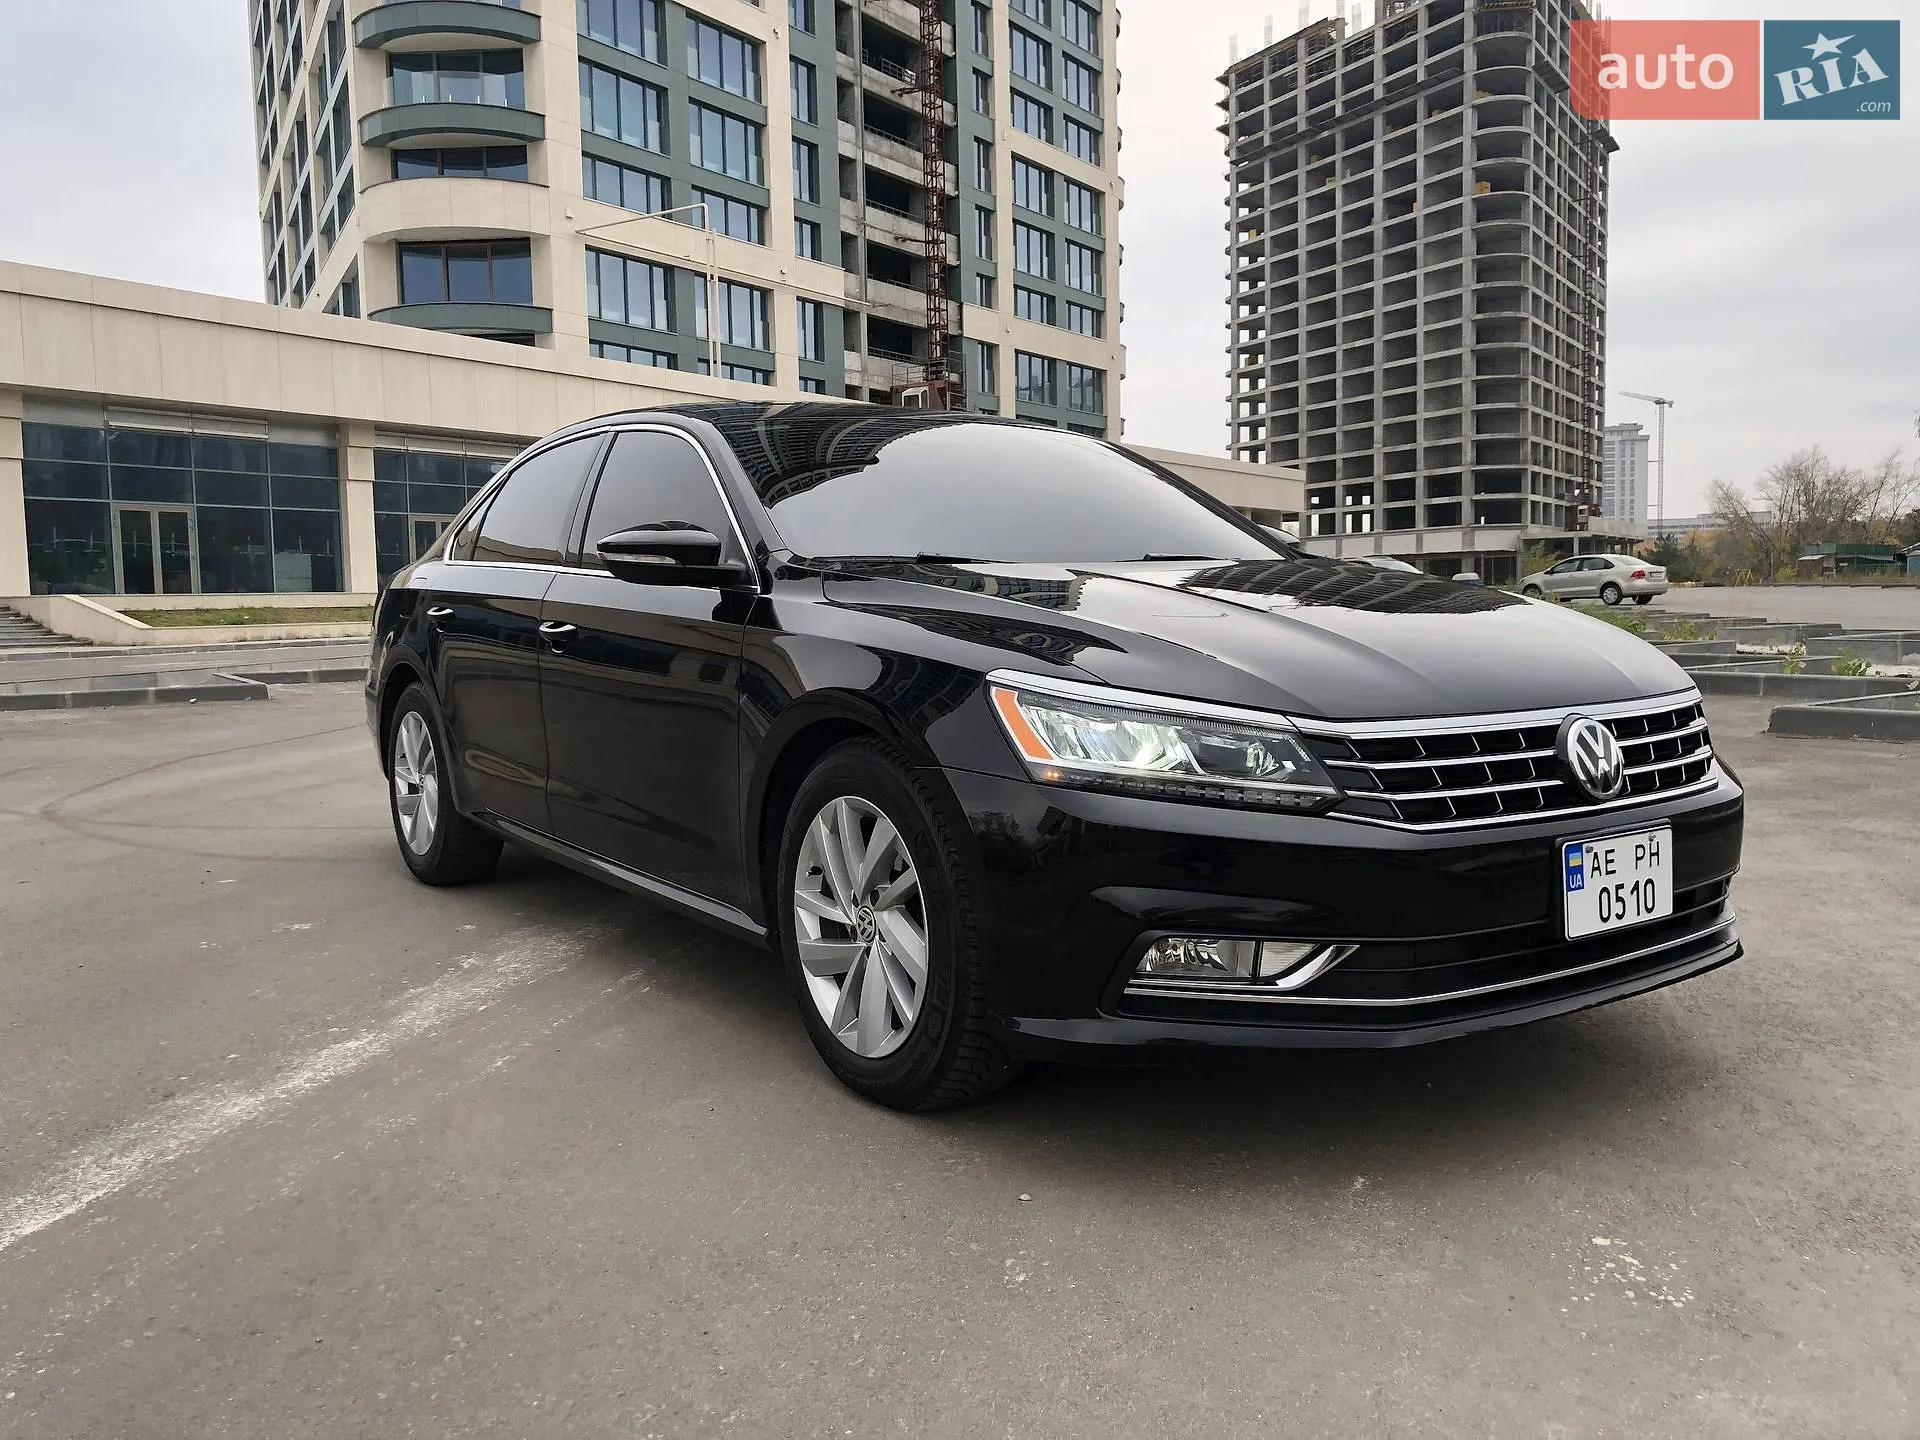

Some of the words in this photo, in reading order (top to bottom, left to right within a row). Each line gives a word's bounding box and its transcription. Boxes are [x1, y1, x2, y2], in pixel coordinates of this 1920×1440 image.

[1590, 848, 1617, 878] AE
[1635, 840, 1660, 870] PH
[1569, 874, 1583, 888] UA
[1599, 878, 1656, 923] 0510
